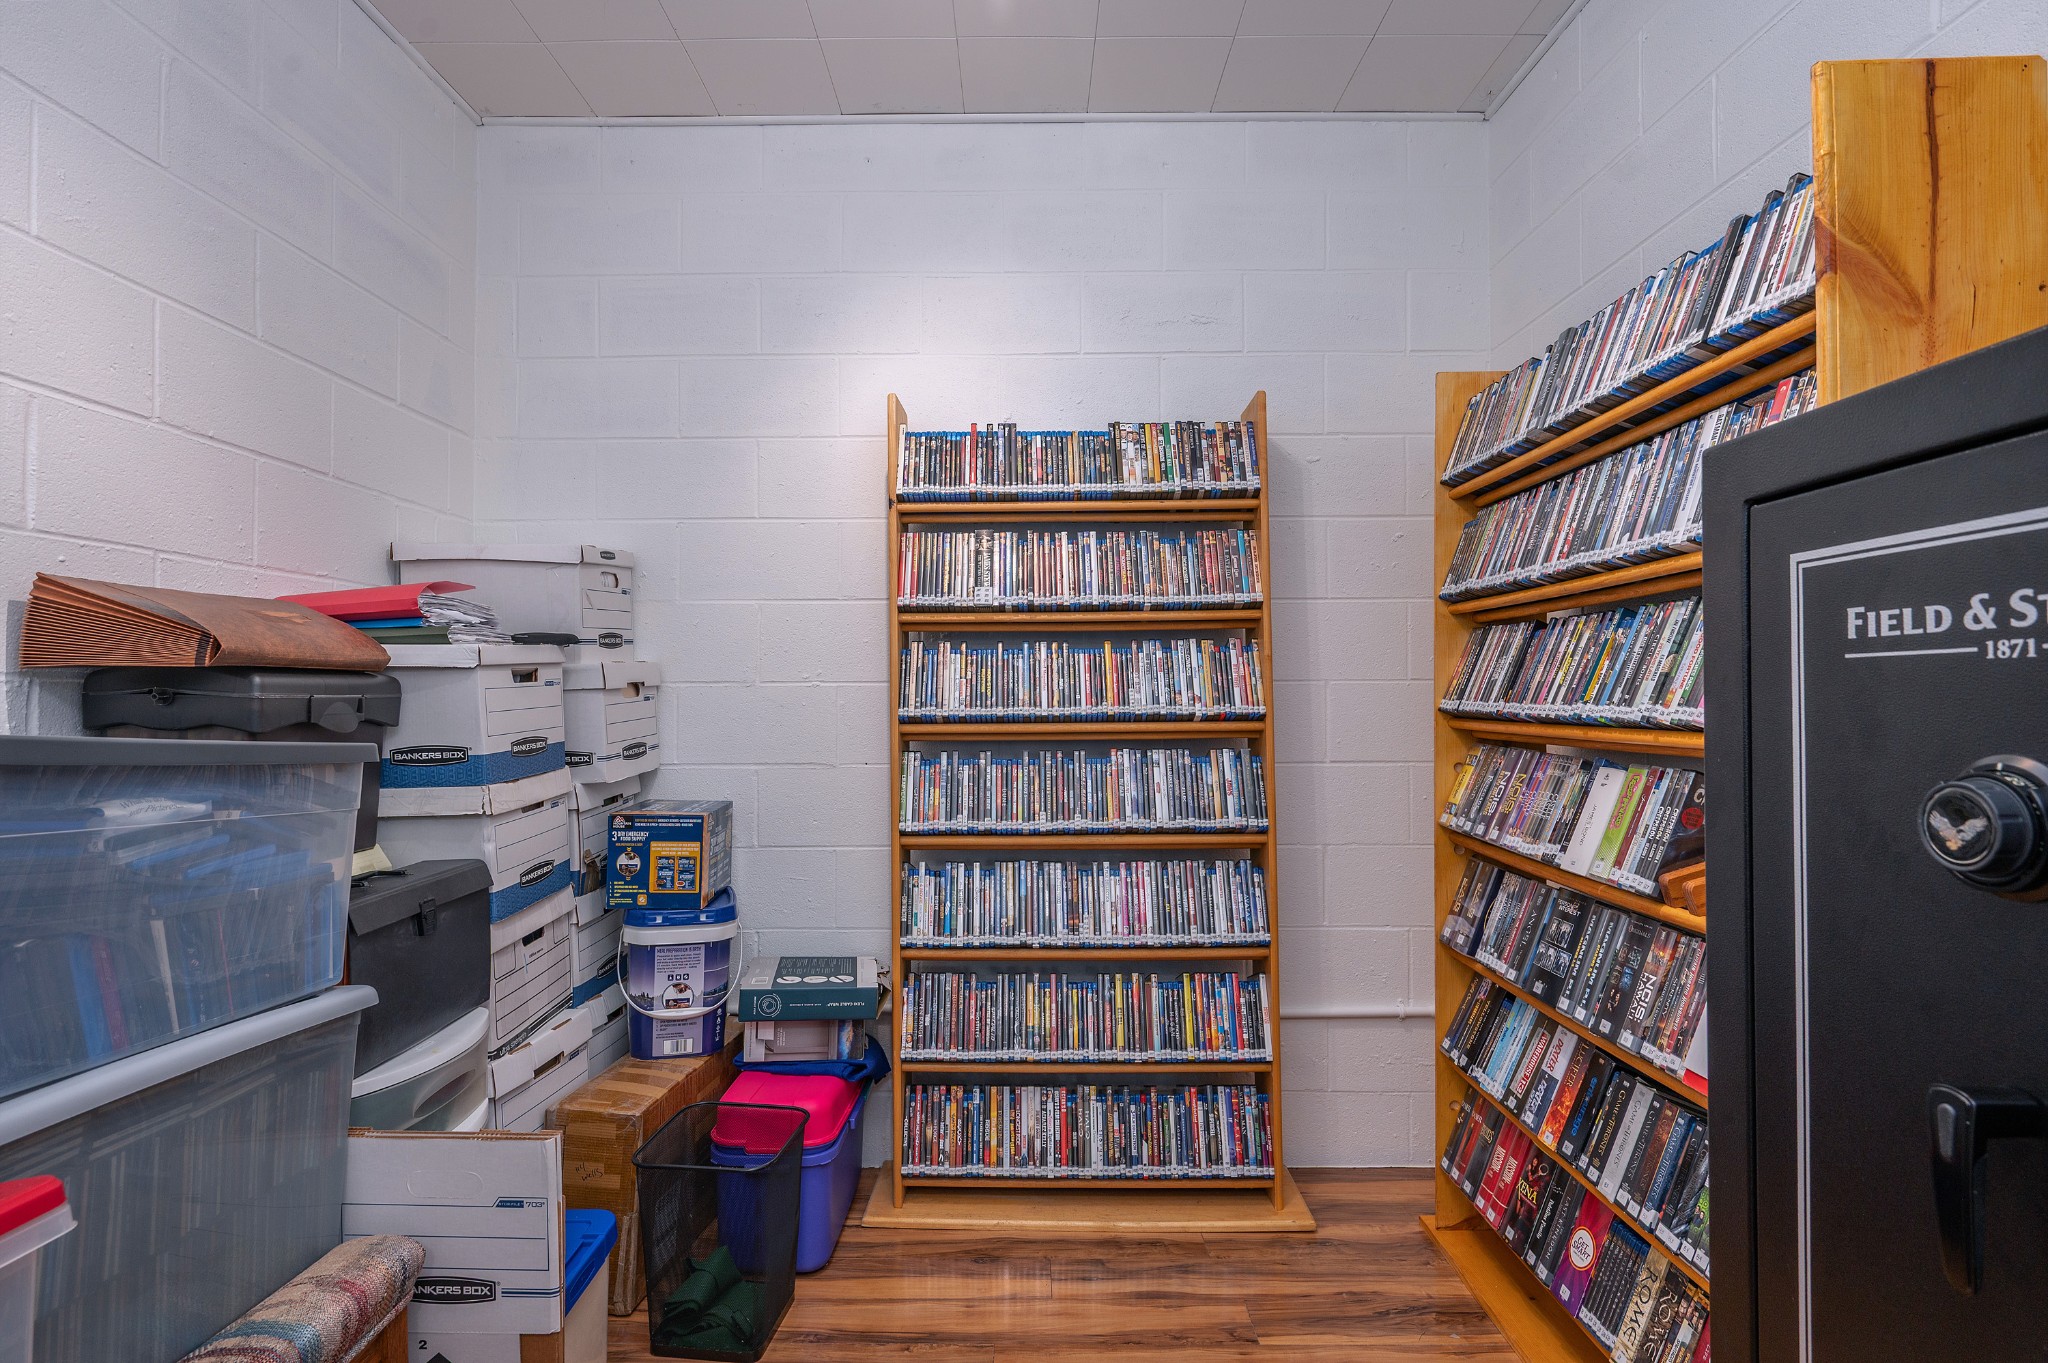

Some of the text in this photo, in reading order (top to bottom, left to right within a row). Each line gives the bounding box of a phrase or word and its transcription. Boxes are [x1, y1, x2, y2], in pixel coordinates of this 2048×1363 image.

[1710, 412, 1724, 441] BATMAN
[1845, 604, 1953, 640] FIELD
[1963, 592, 1998, 631] &
[599, 637, 615, 645] BANKERS
[1984, 637, 2037, 659] 1871
[1678, 655, 1695, 689] FORTUNE
[394, 751, 464, 760] BANKERS BOX
[513, 742, 546, 753] BANKERS BOX
[571, 755, 590, 763] BOX
[1486, 769, 1511, 817] NCIS:
[1502, 772, 1527, 815] NCIS:
[611, 831, 618, 841] 3
[1646, 805, 1664, 839] CREEPSHOW
[1654, 805, 1672, 840] CREEPSHOW
[1660, 807, 1679, 842] CREEPSHOW
[521, 864, 553, 883] BANKERS BOX
[1518, 909, 1538, 948] ANGEL
[1570, 914, 1597, 976] MAGNUM
[1587, 921, 1614, 985] MAGNUM
[1633, 974, 1657, 1023] NCIS:
[1661, 976, 1679, 1017] SERENITY
[1465, 999, 1491, 1049] YELLOWSTONE
[1515, 1035, 1547, 1094] WAREHOUSE 13
[1527, 1037, 1565, 1114] DEXTER DEXTER
[1564, 1041, 1590, 1088] LUCIFER
[1568, 1075, 1600, 1137] entourage
[1595, 1117, 1616, 1156] THRONES
[1611, 1128, 1631, 1167] THRONES
[1625, 1140, 1645, 1180] THRONES
[1649, 1157, 1671, 1199] THRONES
[1516, 1177, 1537, 1205] XENA
[1571, 1240, 1591, 1261] SMART
[1577, 1235, 1590, 1249] GET
[411, 1285, 491, 1295] ANKERS BOX
[1623, 1267, 1658, 1345] ROME
[1643, 1287, 1678, 1362] ROME
[418, 1340, 428, 1350] 2
